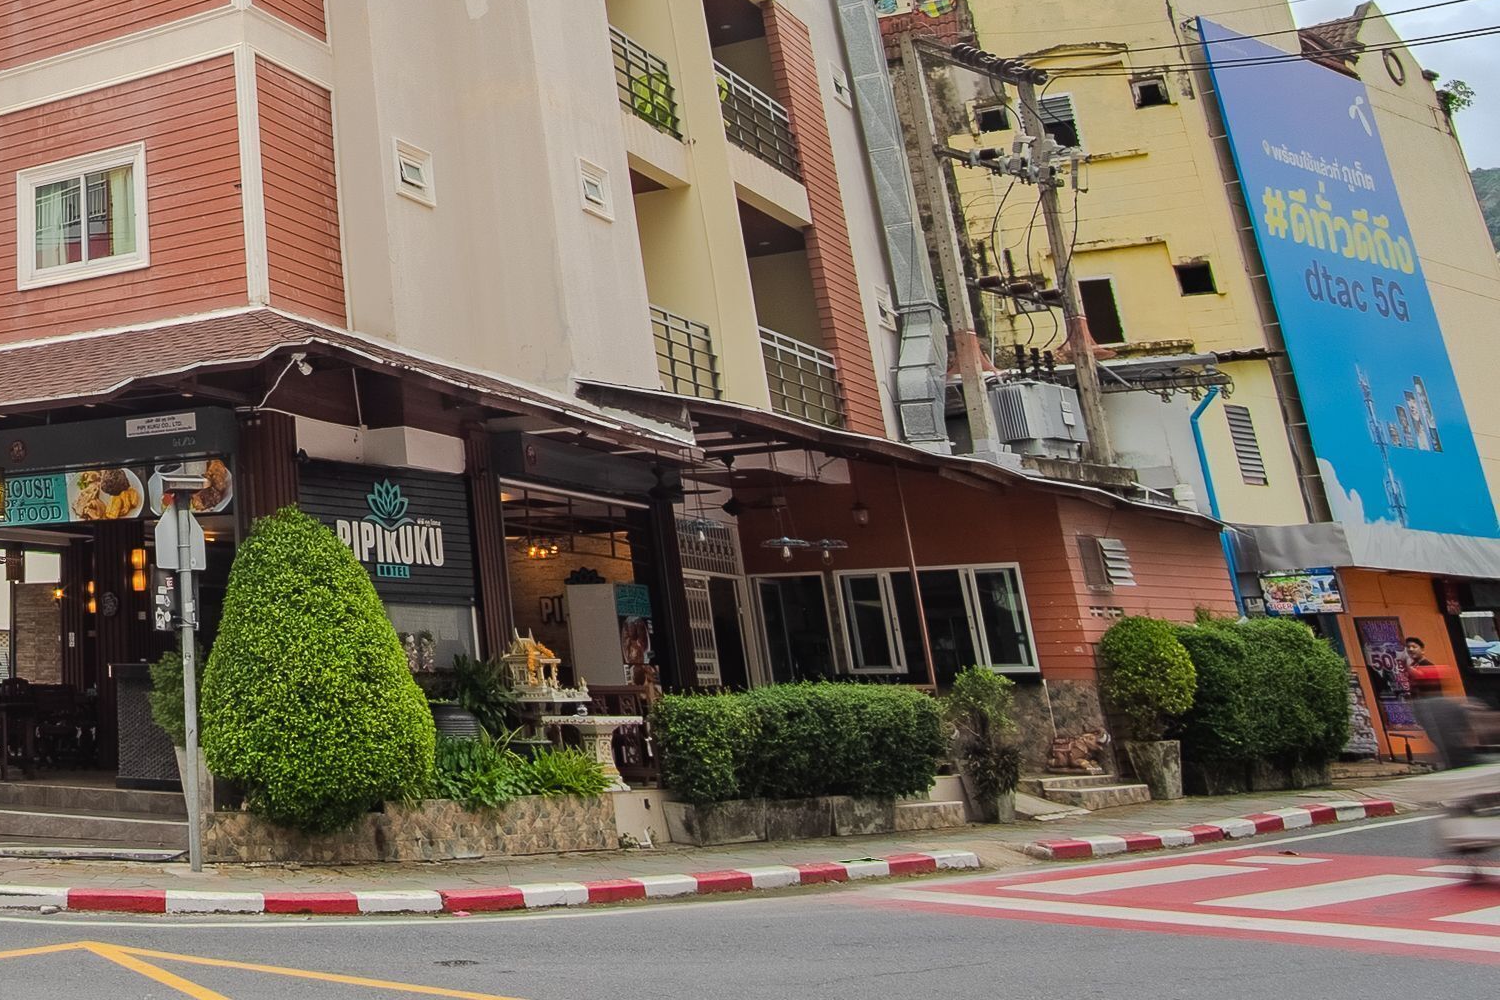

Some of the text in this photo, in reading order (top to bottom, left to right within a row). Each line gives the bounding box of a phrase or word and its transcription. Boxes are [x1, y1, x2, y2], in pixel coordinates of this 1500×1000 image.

[1341, 160, 1376, 193] ภูเก็ต
[1304, 259, 1411, 323] dtac 5G
[3, 477, 54, 500] HOUSE
[17, 505, 62, 522] FOOD
[336, 519, 445, 567] PIPIKUKU
[380, 565, 408, 577] HOTEL
